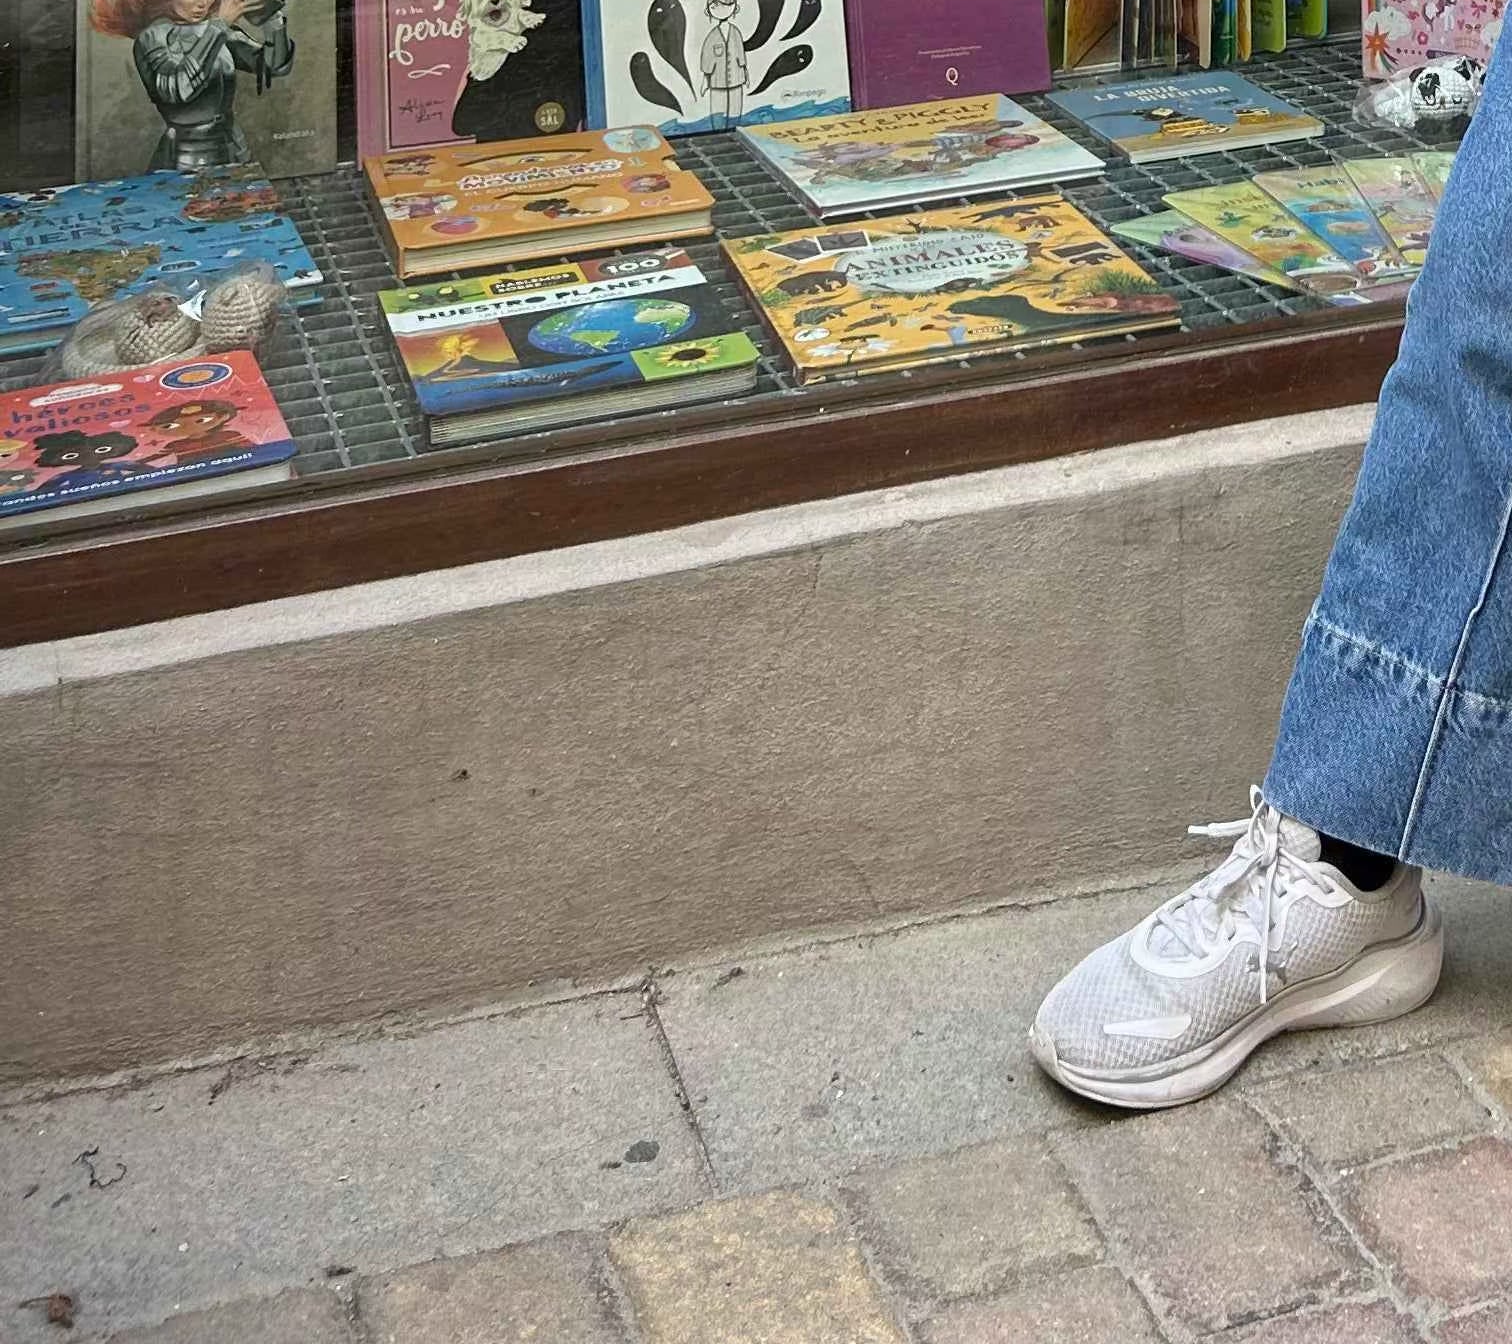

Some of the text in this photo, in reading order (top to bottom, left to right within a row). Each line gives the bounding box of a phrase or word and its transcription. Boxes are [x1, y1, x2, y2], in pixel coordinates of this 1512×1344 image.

[389, 15, 467, 66] perro
[1094, 85, 1182, 103] LA BRUJA
[1140, 86, 1232, 103] DIVERTIDA
[606, 257, 661, 274] 100
[846, 239, 1015, 272] ANIMALES
[855, 250, 1020, 282] EXTINGUIDOS
[417, 295, 548, 322] NUESTRO
[556, 273, 678, 300] PLANETA
[60, 478, 121, 495] sueños
[125, 461, 207, 483] empiezan
